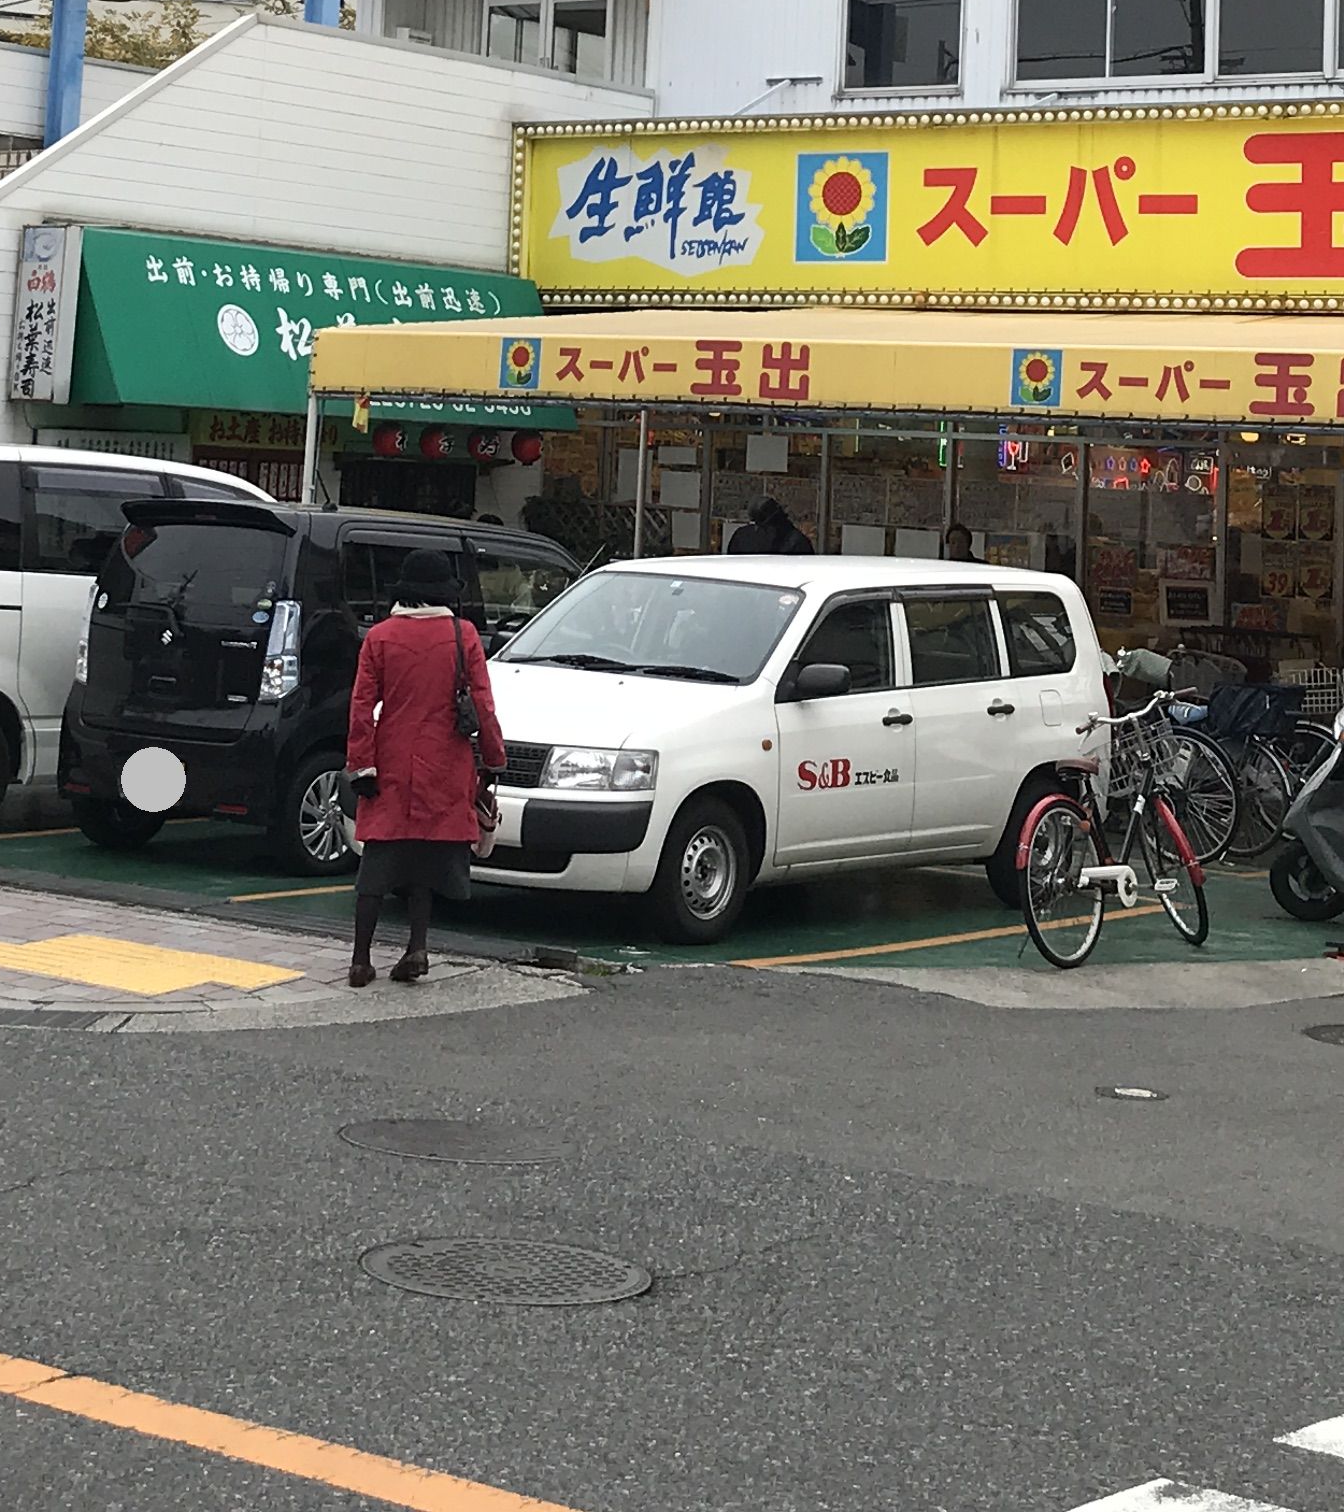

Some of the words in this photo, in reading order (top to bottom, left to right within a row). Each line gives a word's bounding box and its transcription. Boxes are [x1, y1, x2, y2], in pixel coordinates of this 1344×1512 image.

[565, 151, 748, 260] 生鮮館
[916, 155, 1199, 247] スーパー
[20, 299, 44, 399] 松葉寿司
[555, 346, 678, 383] スーパー
[691, 339, 811, 401] 玉出
[1075, 360, 1232, 404] スーパー
[267, 417, 338, 446] お持り
[797, 758, 851, 791] S&B
